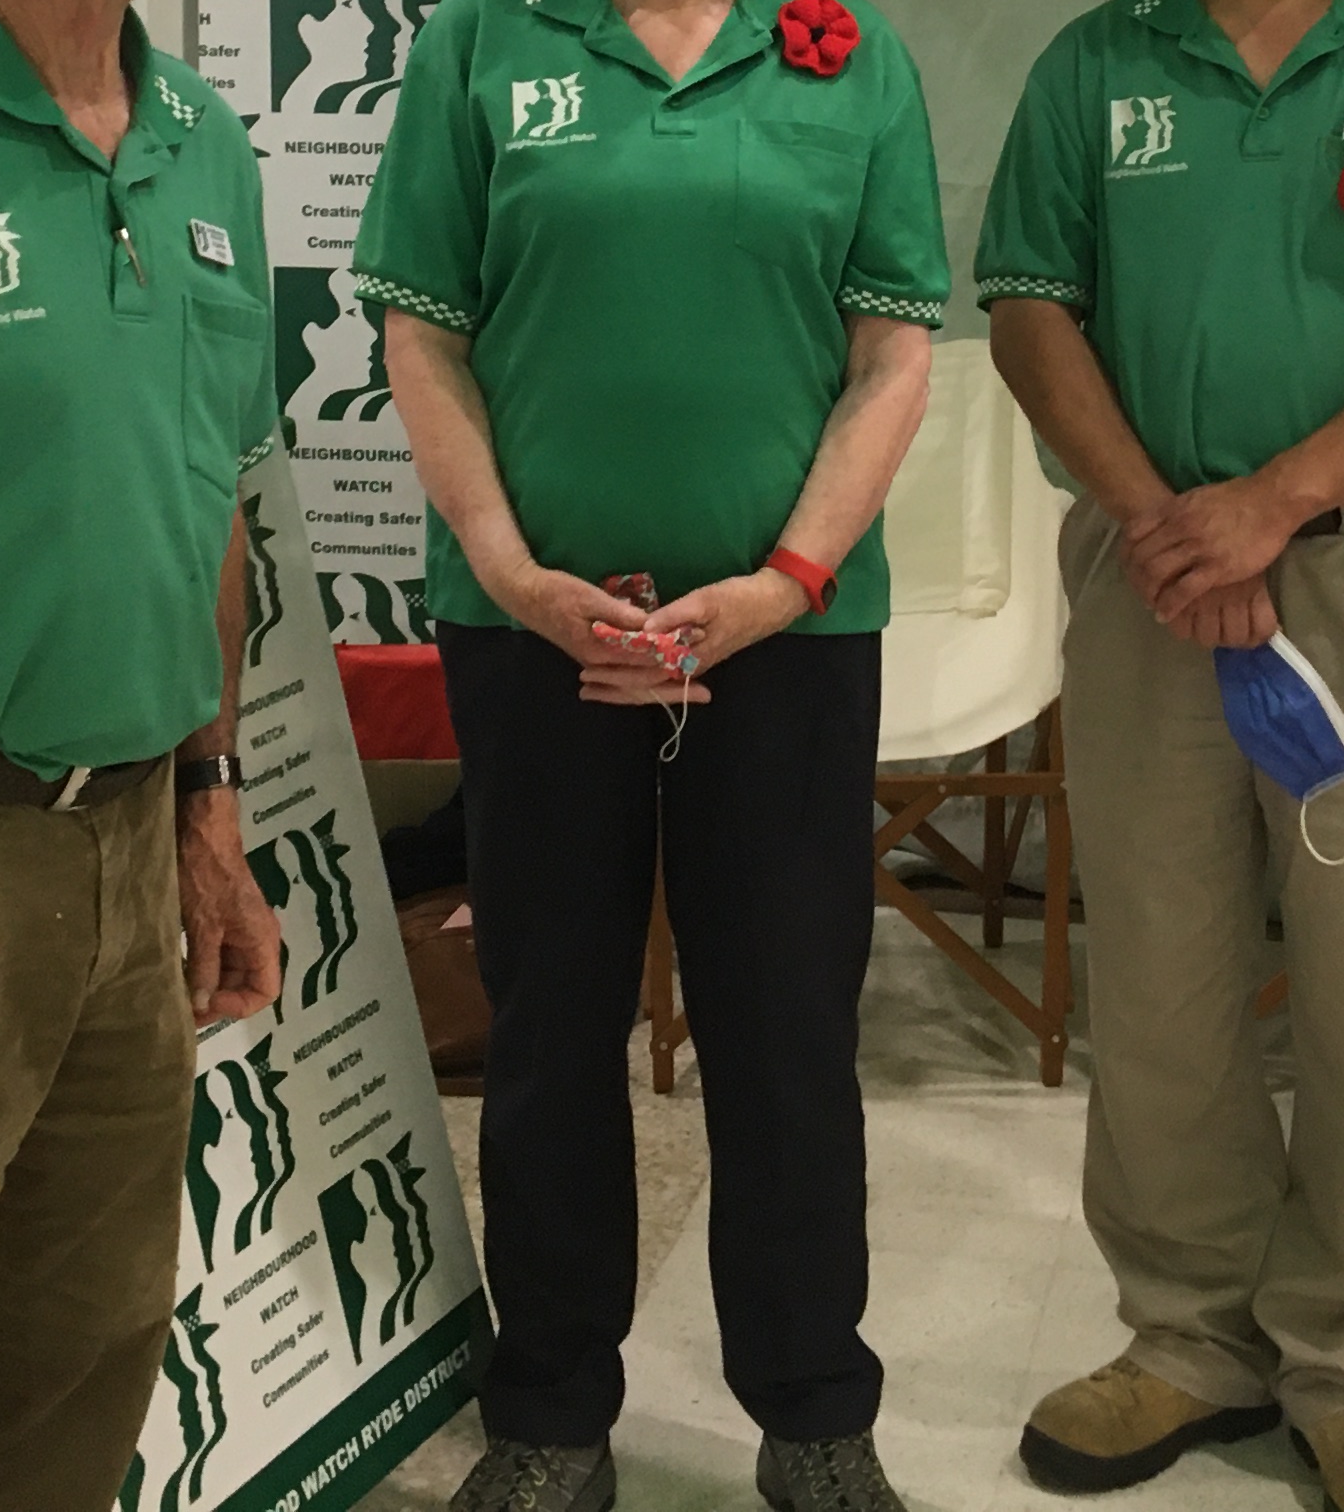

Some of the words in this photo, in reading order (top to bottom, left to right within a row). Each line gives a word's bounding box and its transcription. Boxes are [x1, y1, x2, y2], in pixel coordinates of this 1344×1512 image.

[334, 480, 392, 492] WATCH
[306, 510, 373, 527] Creating
[380, 512, 422, 525] Safer
[311, 542, 416, 556] Communities
[293, 1000, 380, 1064] NEIGHBOURHOOD
[327, 1049, 363, 1081] WATCH
[319, 1092, 360, 1126] Creating
[362, 1074, 386, 1097] Safer
[330, 1110, 391, 1158] Communities
[223, 1230, 317, 1310] NEIGHBOURHOOD
[260, 1286, 299, 1324] WATCH
[251, 1333, 296, 1374] Creating
[298, 1311, 324, 1338] Safer
[263, 1349, 329, 1408] Communities
[301, 1437, 359, 1500] WATCH
[361, 1400, 404, 1450] RYDE
[404, 1341, 471, 1412] DISTRICT
